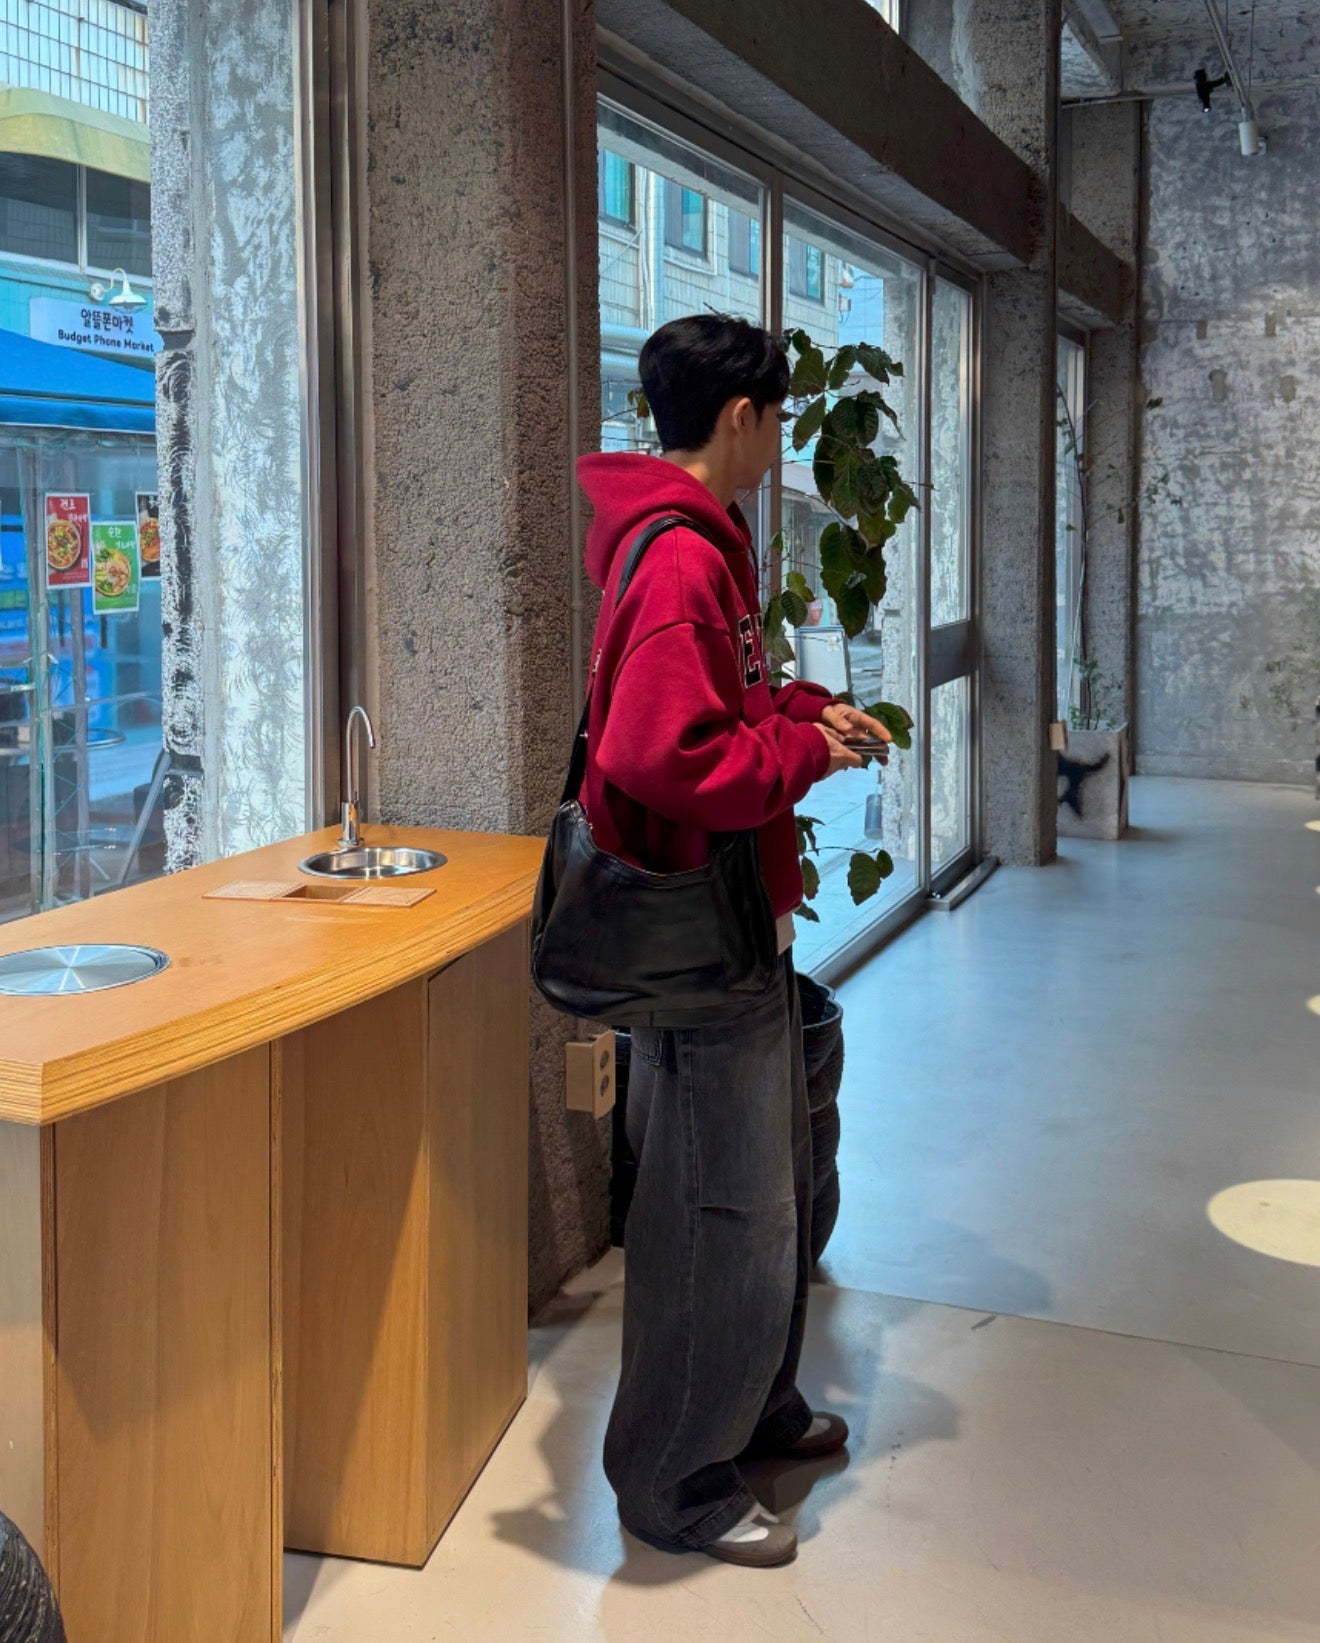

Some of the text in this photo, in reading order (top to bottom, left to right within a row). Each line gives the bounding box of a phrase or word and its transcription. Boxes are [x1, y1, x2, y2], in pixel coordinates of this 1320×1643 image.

[81, 309, 133, 334] 알뜰폰마켓
[58, 330, 154, 352] Budget Phone Market
